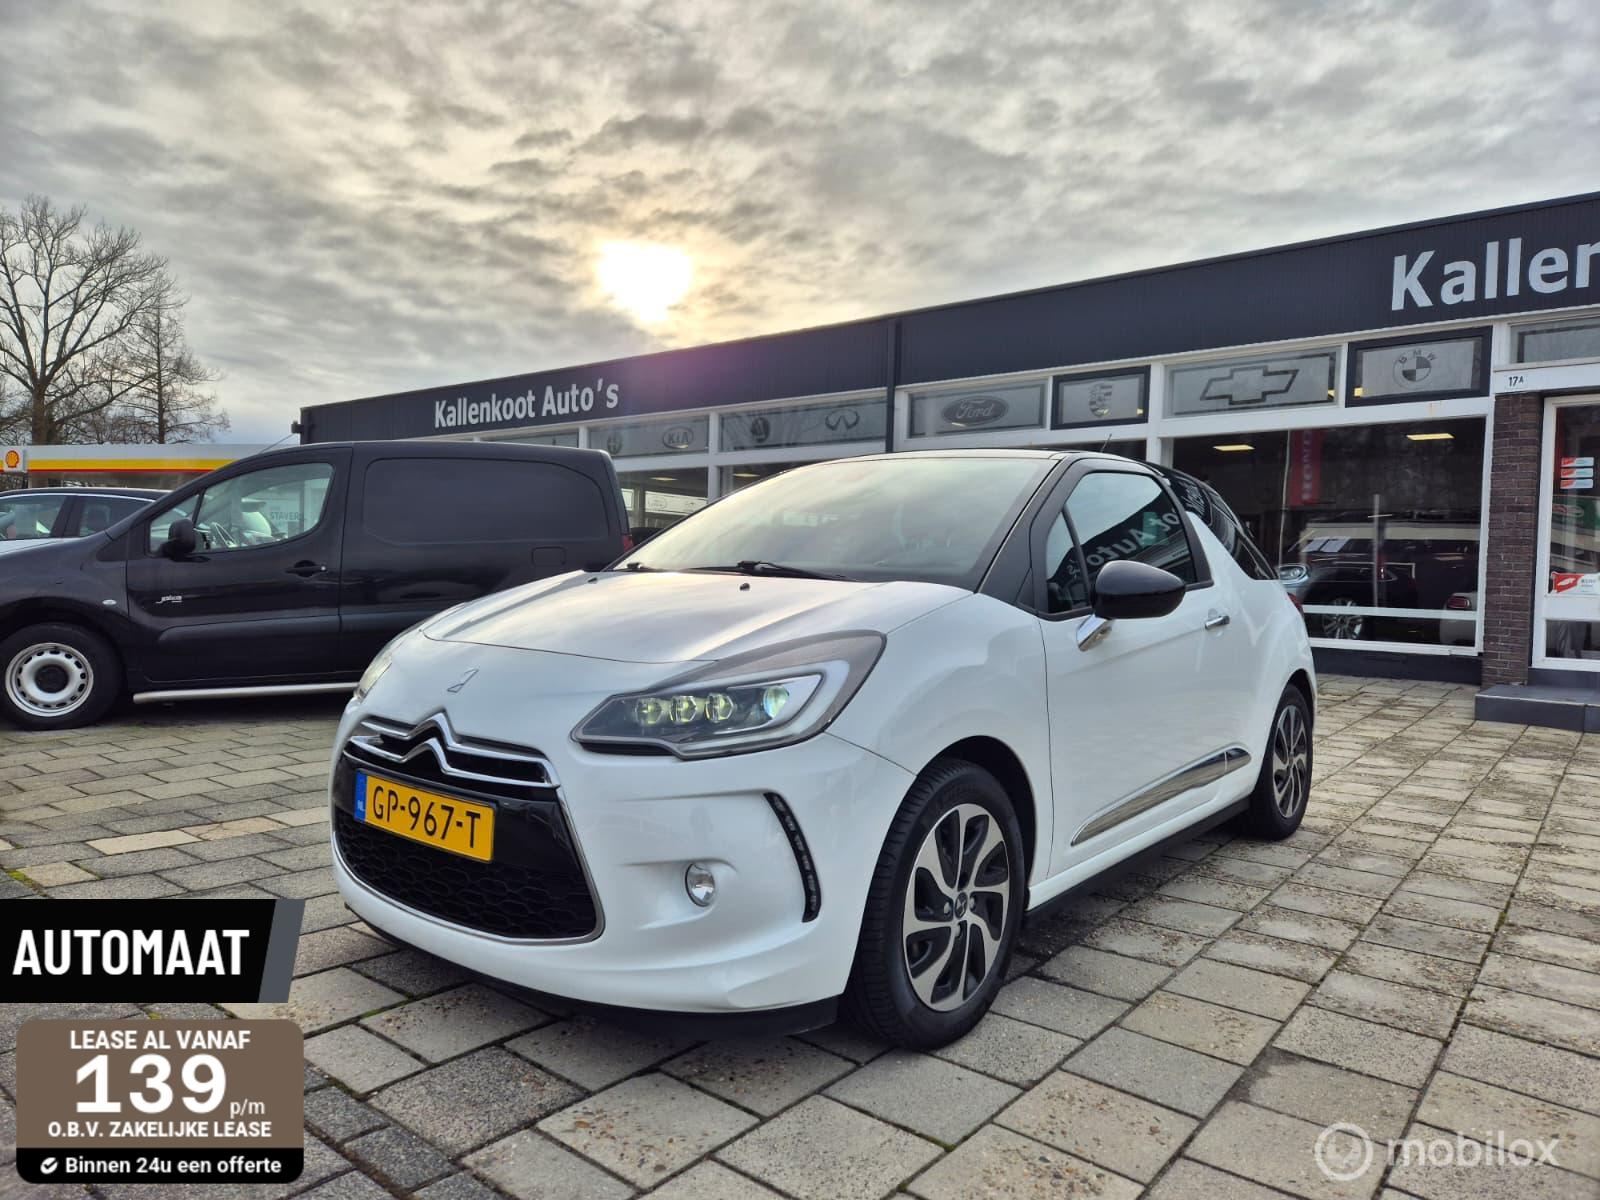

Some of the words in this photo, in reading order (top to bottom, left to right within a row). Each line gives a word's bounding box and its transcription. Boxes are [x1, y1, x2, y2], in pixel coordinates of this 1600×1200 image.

[1509, 375, 1524, 387] 17A
[435, 391, 535, 429] Kallenkoot
[541, 378, 619, 417] Auto's
[956, 400, 995, 419] Ford
[668, 431, 689, 444] KIA
[373, 785, 481, 849] GP-967-T
